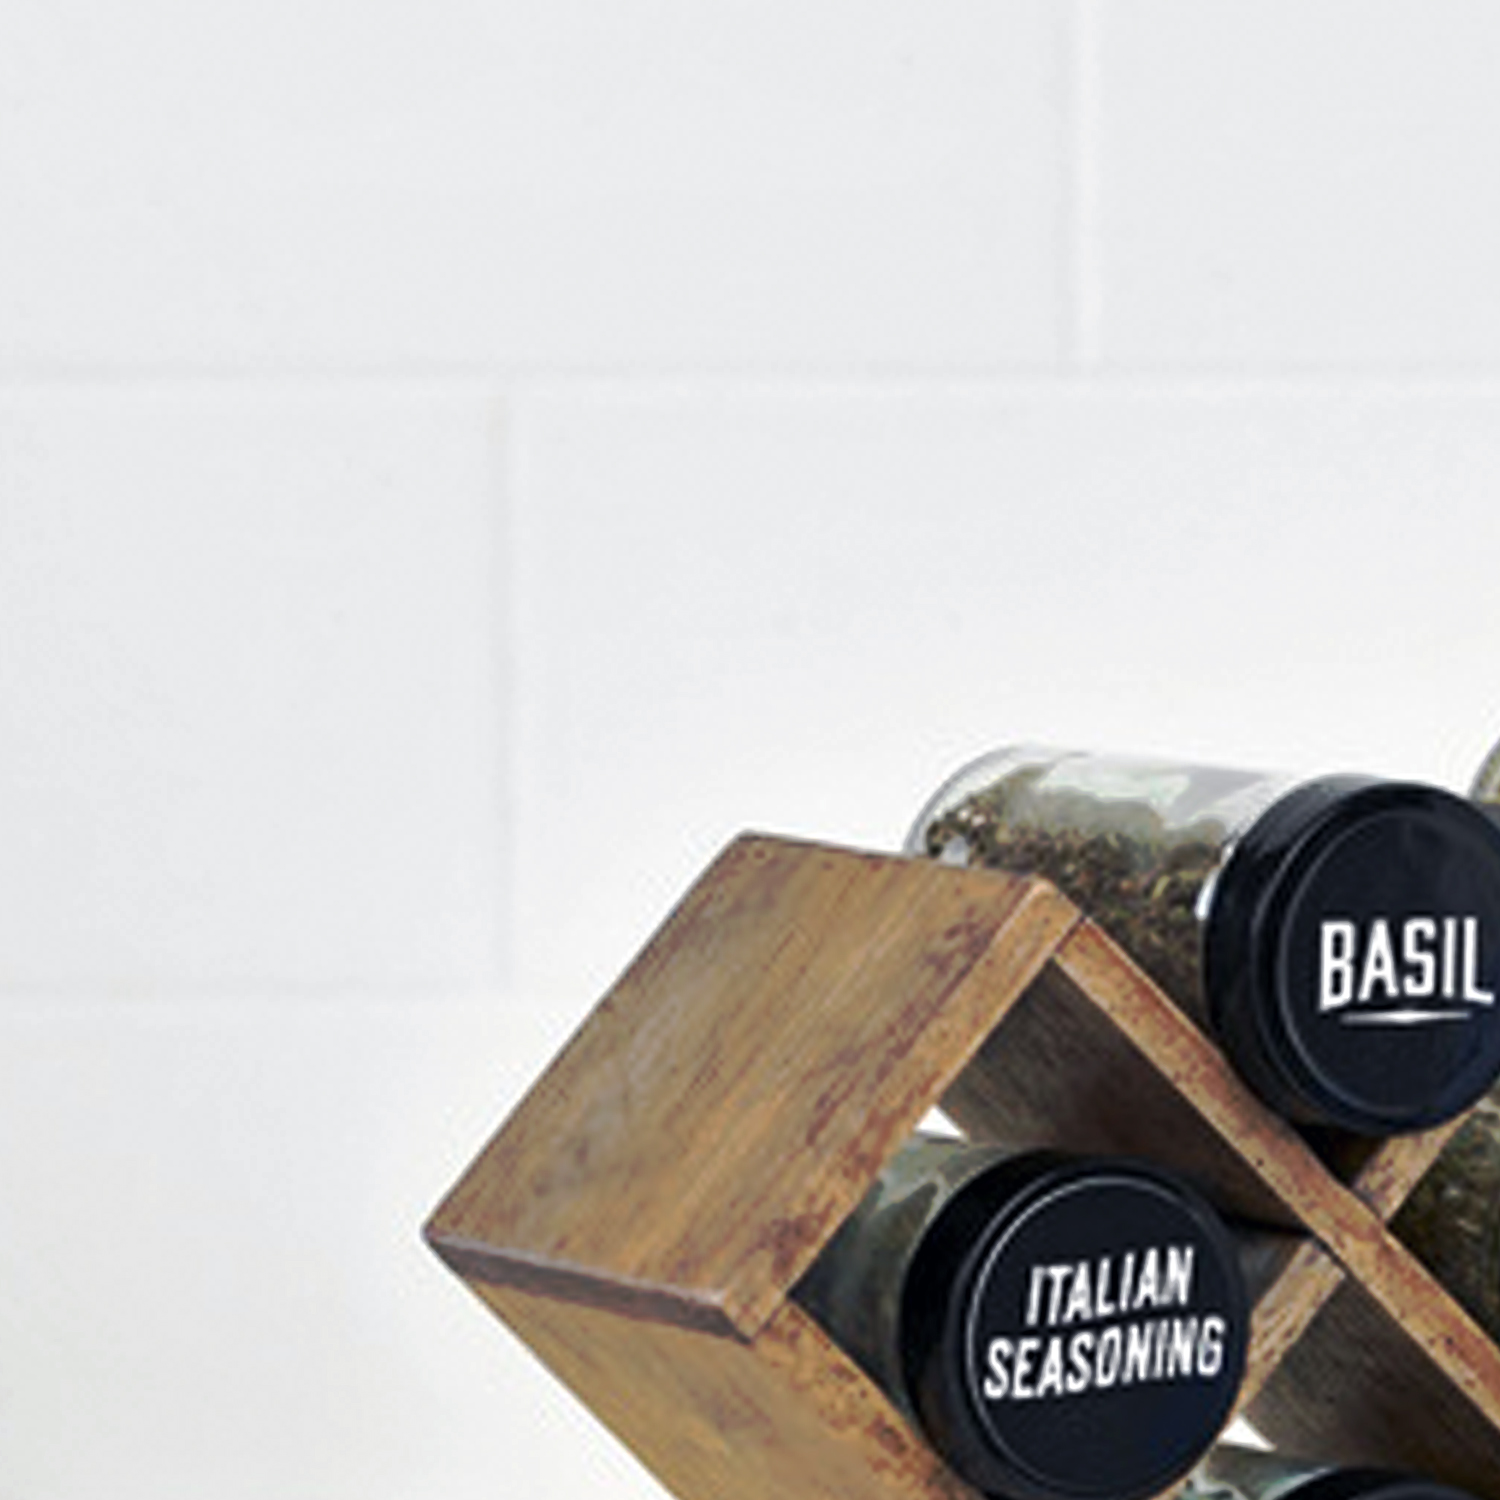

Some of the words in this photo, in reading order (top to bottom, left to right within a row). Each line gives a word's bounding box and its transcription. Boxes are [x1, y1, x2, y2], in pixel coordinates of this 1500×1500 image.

[1318, 915, 1496, 1012] BASIL
[1025, 1245, 1195, 1327] ITALIAN
[982, 1315, 1226, 1401] SEASONING
